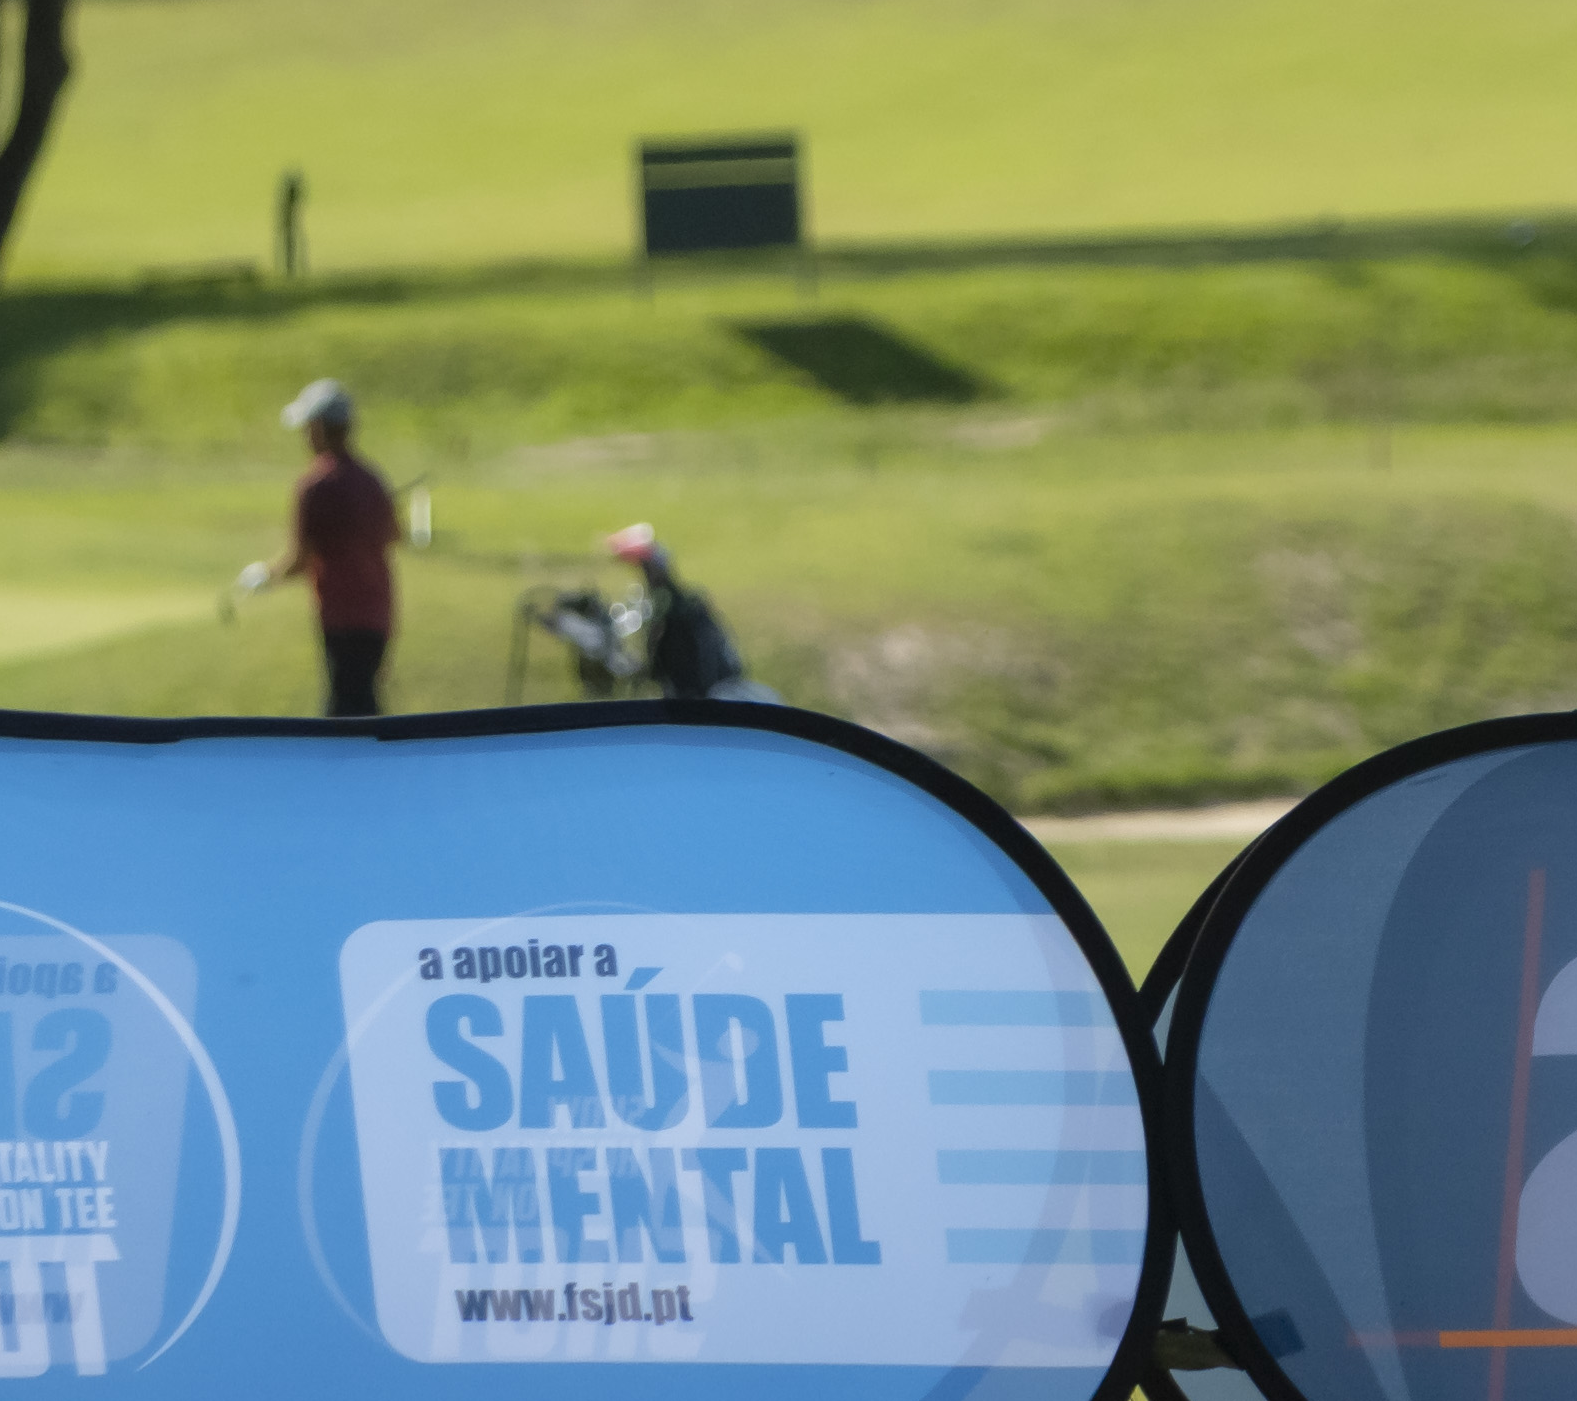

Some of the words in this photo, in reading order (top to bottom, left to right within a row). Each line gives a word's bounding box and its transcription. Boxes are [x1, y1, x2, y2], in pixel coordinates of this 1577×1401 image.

[418, 947, 444, 980] a
[452, 938, 584, 984] apoiar
[593, 943, 618, 977] a
[425, 966, 858, 1133] SAÚDE
[55, 1186, 117, 1229] TEE
[438, 1146, 883, 1265] MENTAL
[454, 1282, 694, 1325] www.fsjd.pt
